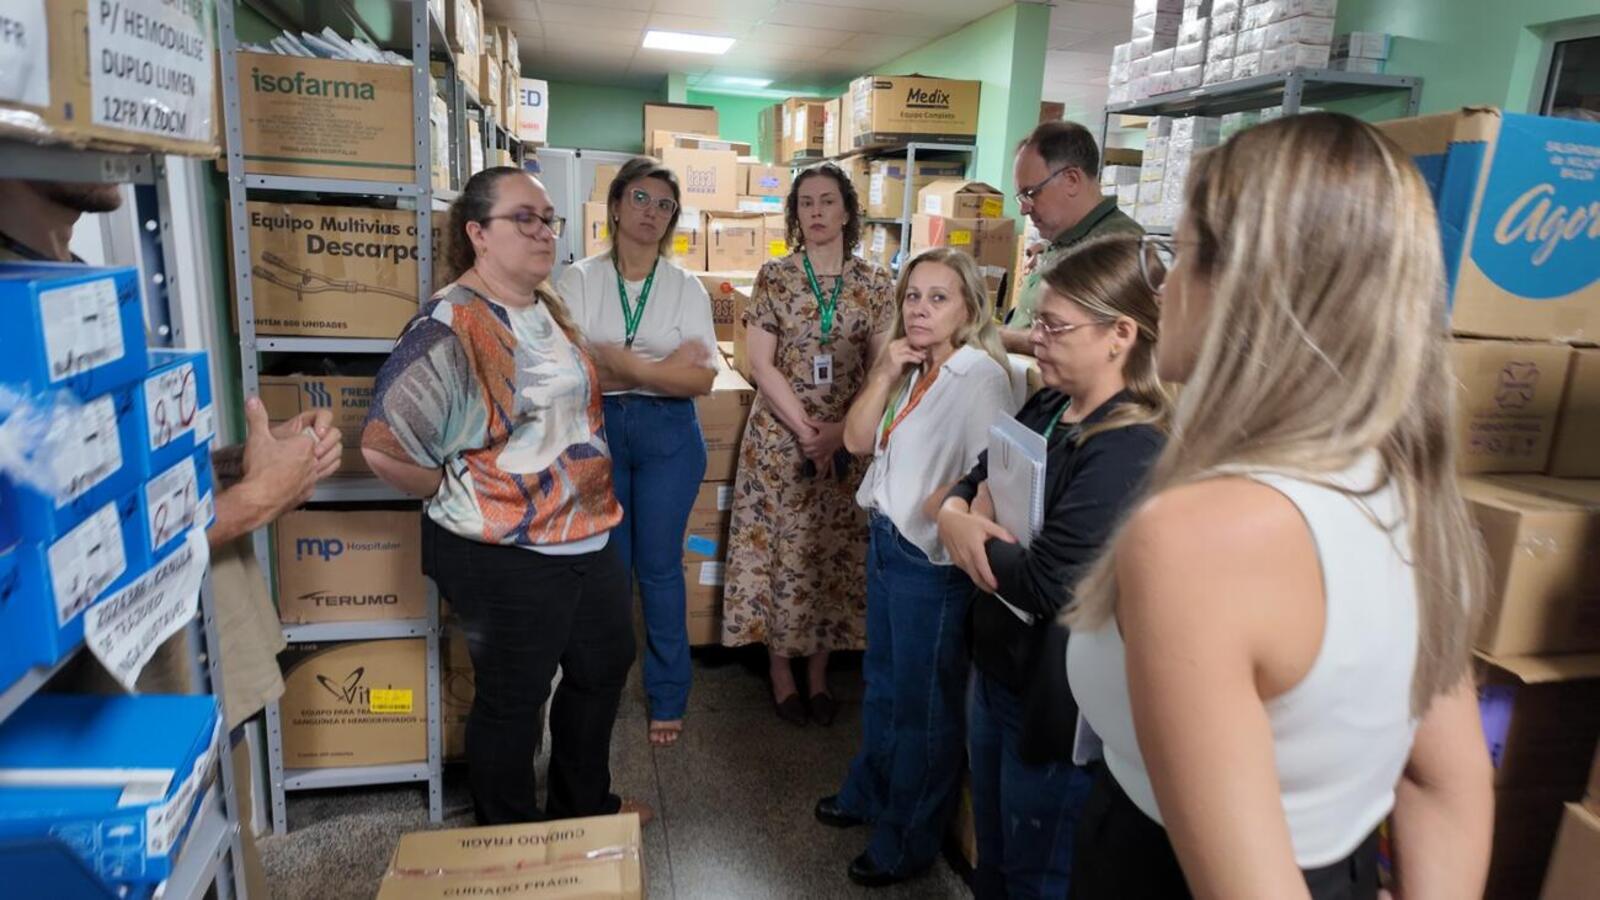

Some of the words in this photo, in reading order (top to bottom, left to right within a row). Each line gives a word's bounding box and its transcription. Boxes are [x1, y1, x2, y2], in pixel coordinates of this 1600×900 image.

[124, 9, 204, 61] HEMODIALISE
[102, 49, 153, 85] DUPLO
[156, 65, 195, 97] LUMEN
[252, 67, 375, 100] isofarma
[906, 88, 950, 105] Medix
[103, 97, 138, 126] 12FR
[140, 104, 150, 126] X
[251, 211, 314, 231] Equipo
[320, 216, 400, 236] Multivias
[302, 319, 349, 330] UNIDADES
[341, 387, 375, 397] FRES
[311, 594, 398, 607] TERUMO
[518, 828, 586, 848] CUIDADO
[443, 884, 519, 898] CUIDADO
